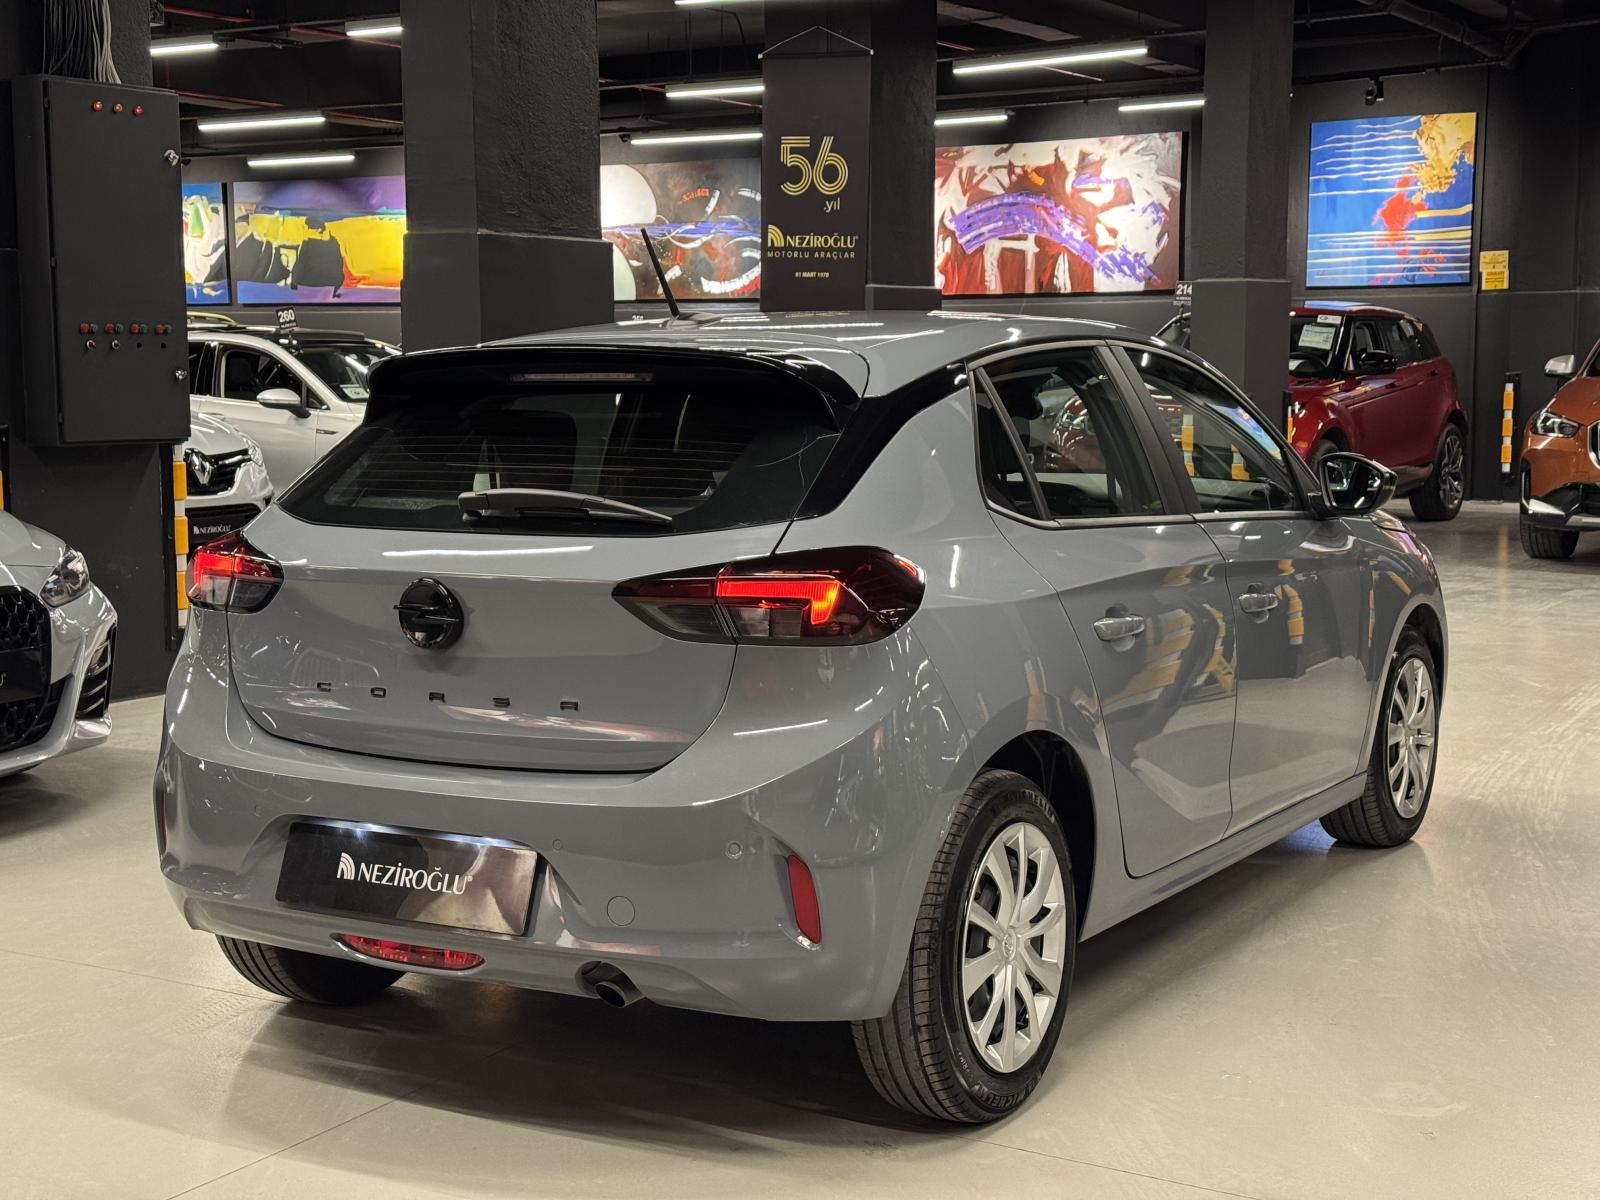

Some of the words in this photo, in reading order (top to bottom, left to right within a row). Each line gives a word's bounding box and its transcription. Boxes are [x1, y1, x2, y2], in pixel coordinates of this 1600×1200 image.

[780, 135, 849, 196] 56
[786, 232, 856, 248] NEZİROĞLU
[767, 250, 810, 259] MOTORLU
[814, 251, 855, 261] ARAÇLAR
[1176, 284, 1193, 295] 214
[278, 309, 295, 323] 260
[357, 861, 469, 895] NEZİROĞLU
